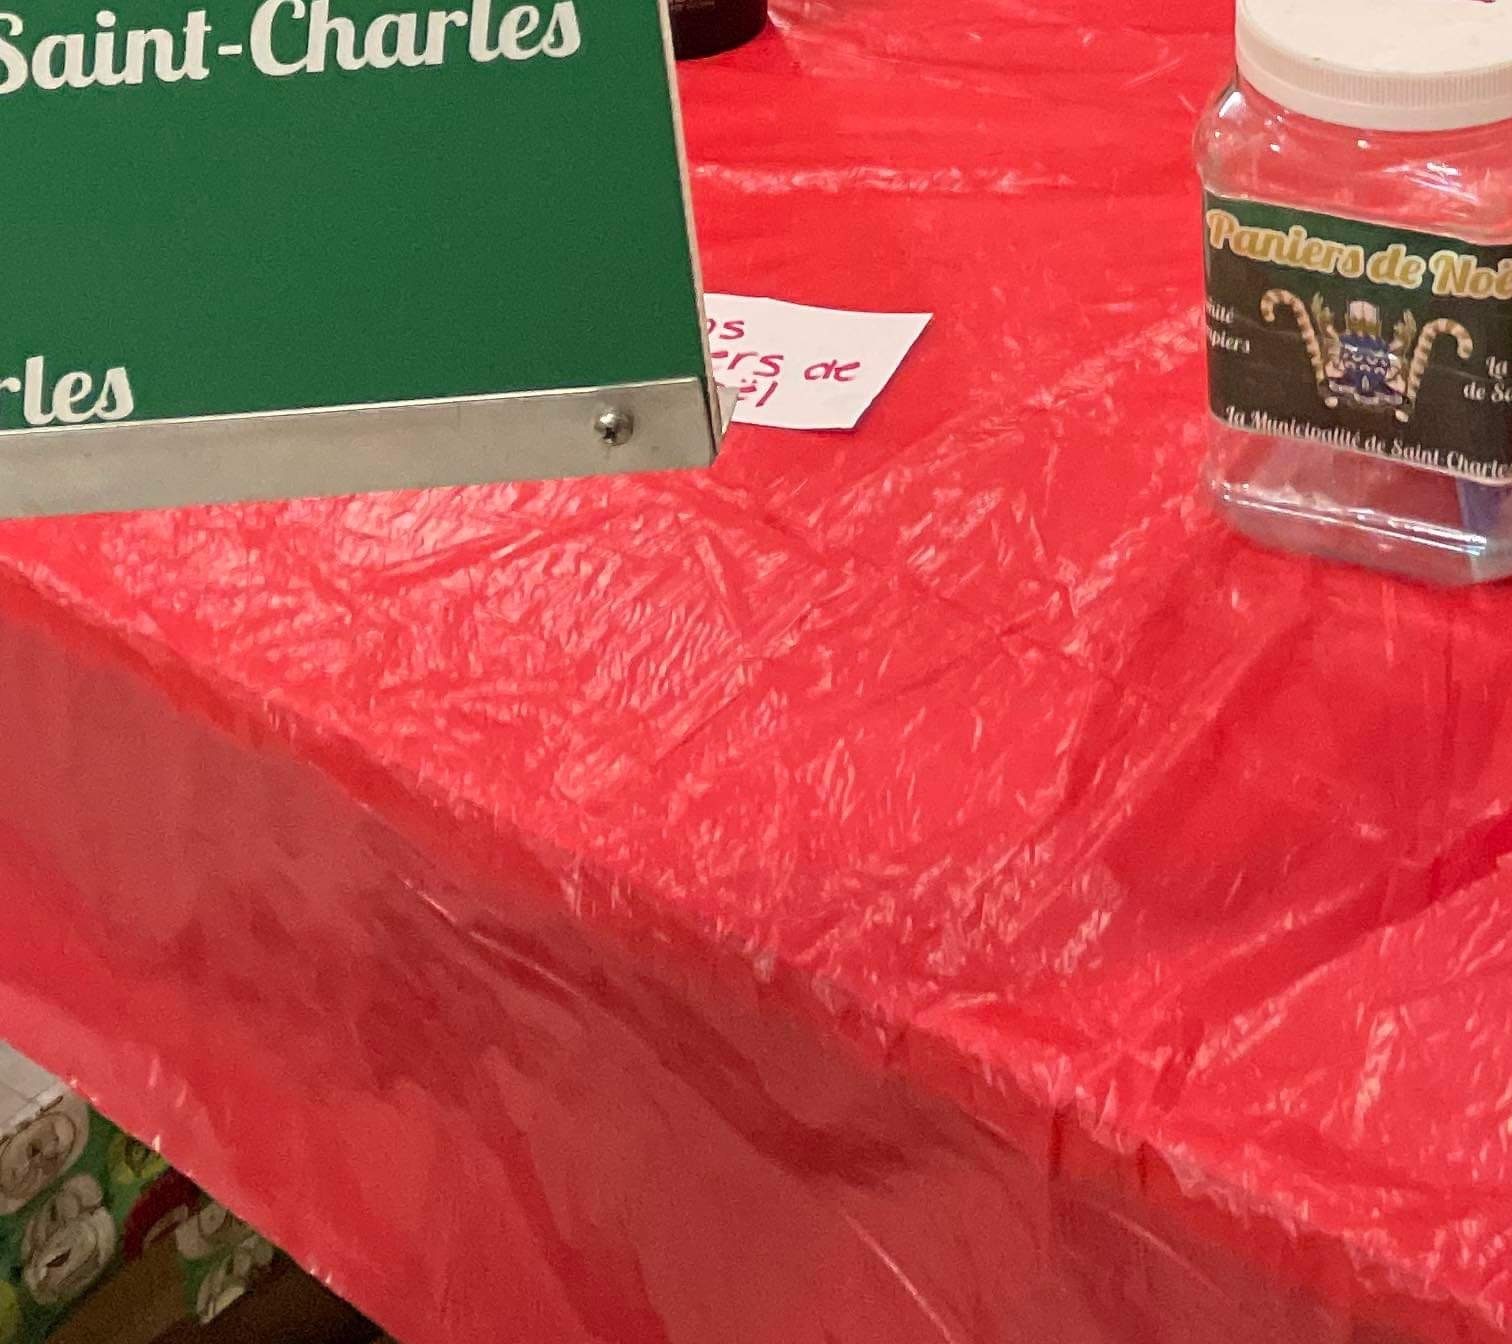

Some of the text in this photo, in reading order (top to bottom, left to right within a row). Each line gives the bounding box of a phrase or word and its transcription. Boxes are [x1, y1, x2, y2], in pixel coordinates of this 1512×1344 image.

[1207, 209, 1364, 278] Paniers
[1367, 245, 1426, 290] de
[804, 359, 861, 382] de
[1463, 381, 1486, 401] de
